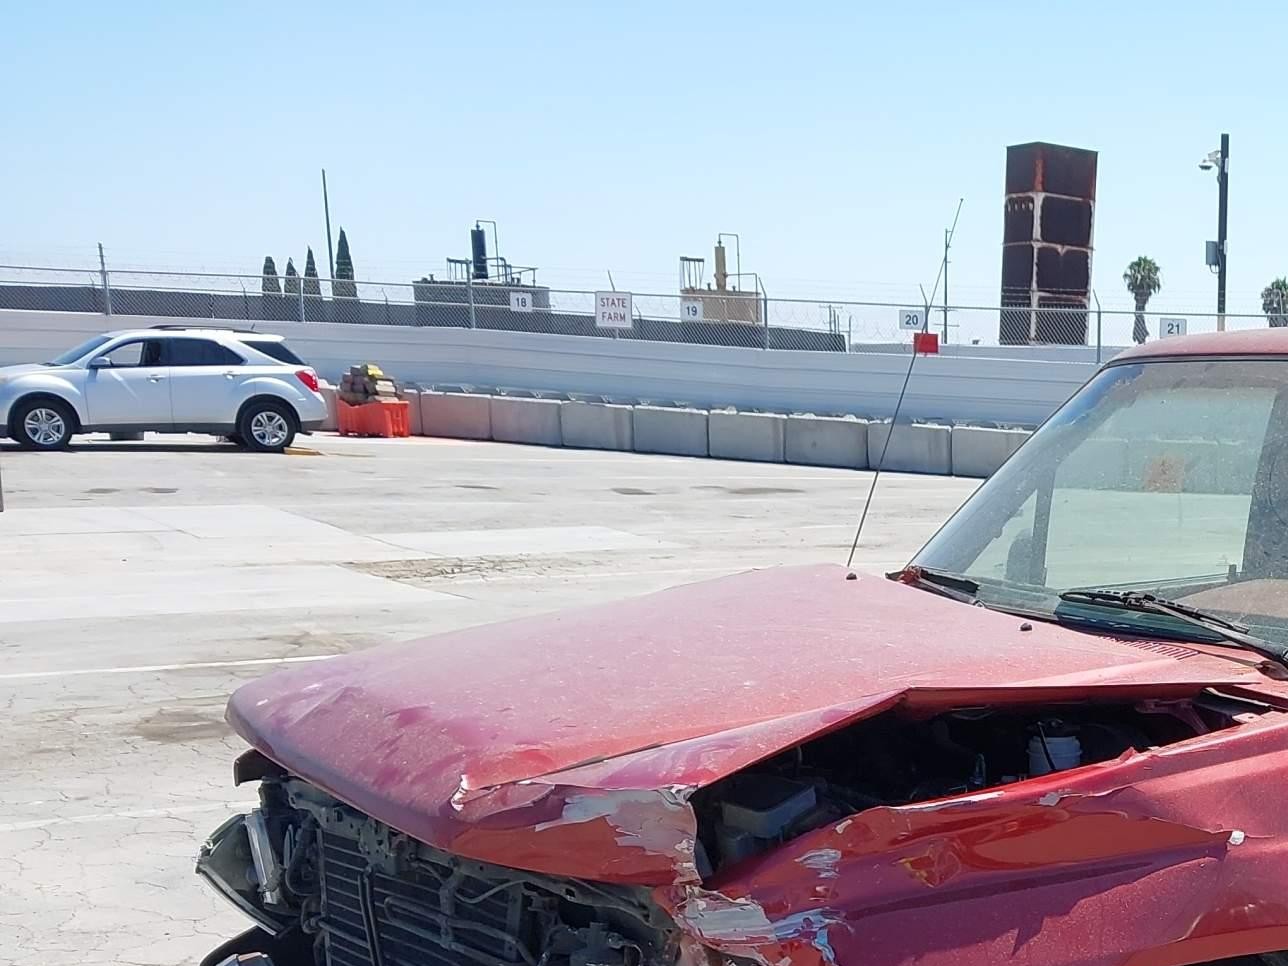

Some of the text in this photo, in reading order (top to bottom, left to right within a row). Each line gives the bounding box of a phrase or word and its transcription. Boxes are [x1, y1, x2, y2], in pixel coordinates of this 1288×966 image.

[515, 297, 527, 308] 18
[600, 297, 627, 309] STATE
[686, 305, 698, 316] 19
[601, 311, 626, 323] FARM
[905, 314, 919, 326] 20
[1167, 322, 1180, 335] 21
